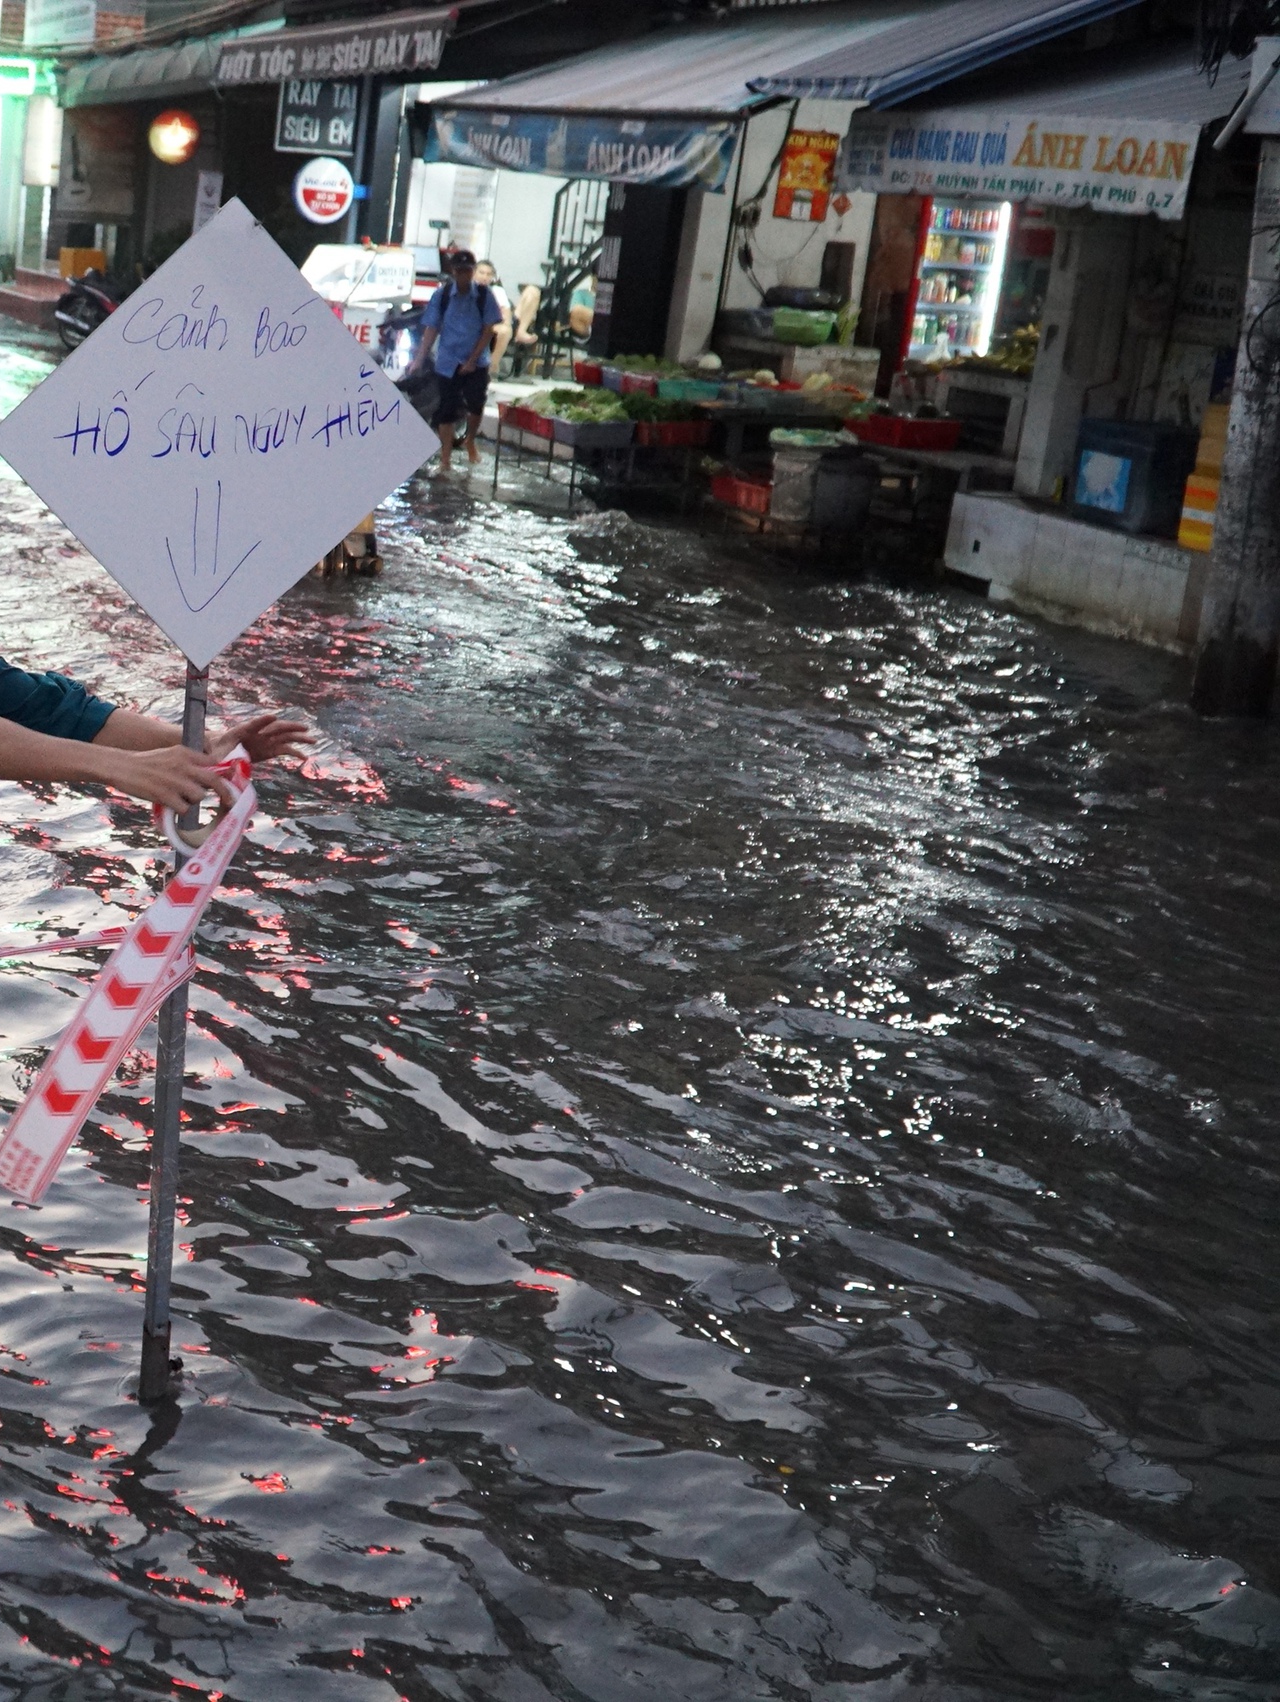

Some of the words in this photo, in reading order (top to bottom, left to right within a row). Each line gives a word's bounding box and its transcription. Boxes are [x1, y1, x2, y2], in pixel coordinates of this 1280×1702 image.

[259, 44, 296, 78] TÓC
[333, 35, 371, 72] SIÊU
[373, 29, 410, 67] RÁY
[333, 83, 358, 109] TAI
[284, 113, 320, 143] SIÊU
[328, 116, 355, 146] ÊM
[788, 134, 808, 146] KIM
[951, 130, 980, 164] RAU
[980, 121, 1010, 169] QUẢ
[1012, 120, 1089, 171] ÁNH
[1092, 135, 1191, 182] LOAN
[936, 171, 980, 190] HUỲNH
[1072, 181, 1103, 200] TÂN
[1108, 186, 1137, 204] PHÚ
[54, 370, 156, 457] HỐ
[151, 383, 217, 458] SÂU
